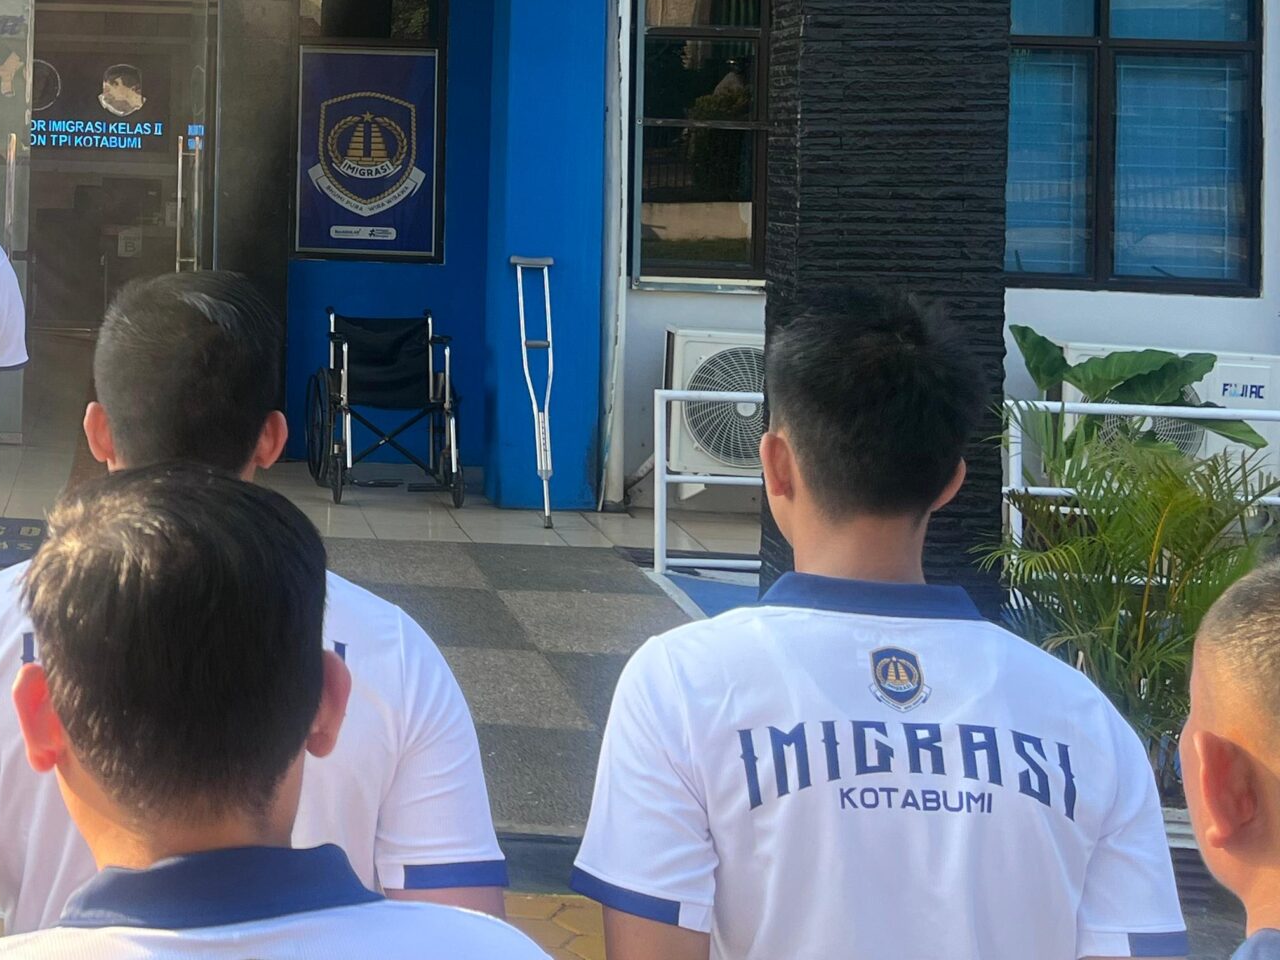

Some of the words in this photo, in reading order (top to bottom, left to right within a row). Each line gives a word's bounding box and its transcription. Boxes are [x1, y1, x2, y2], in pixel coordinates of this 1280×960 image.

[49, 120, 107, 134] IMIGRASI
[108, 122, 152, 136] KELAS
[50, 134, 72, 147] TPI
[74, 136, 142, 149] KOTABUMI
[343, 162, 391, 176] IMIGRASI
[738, 720, 1077, 822] IMIGRASI
[839, 786, 993, 814] KOTABUMI
